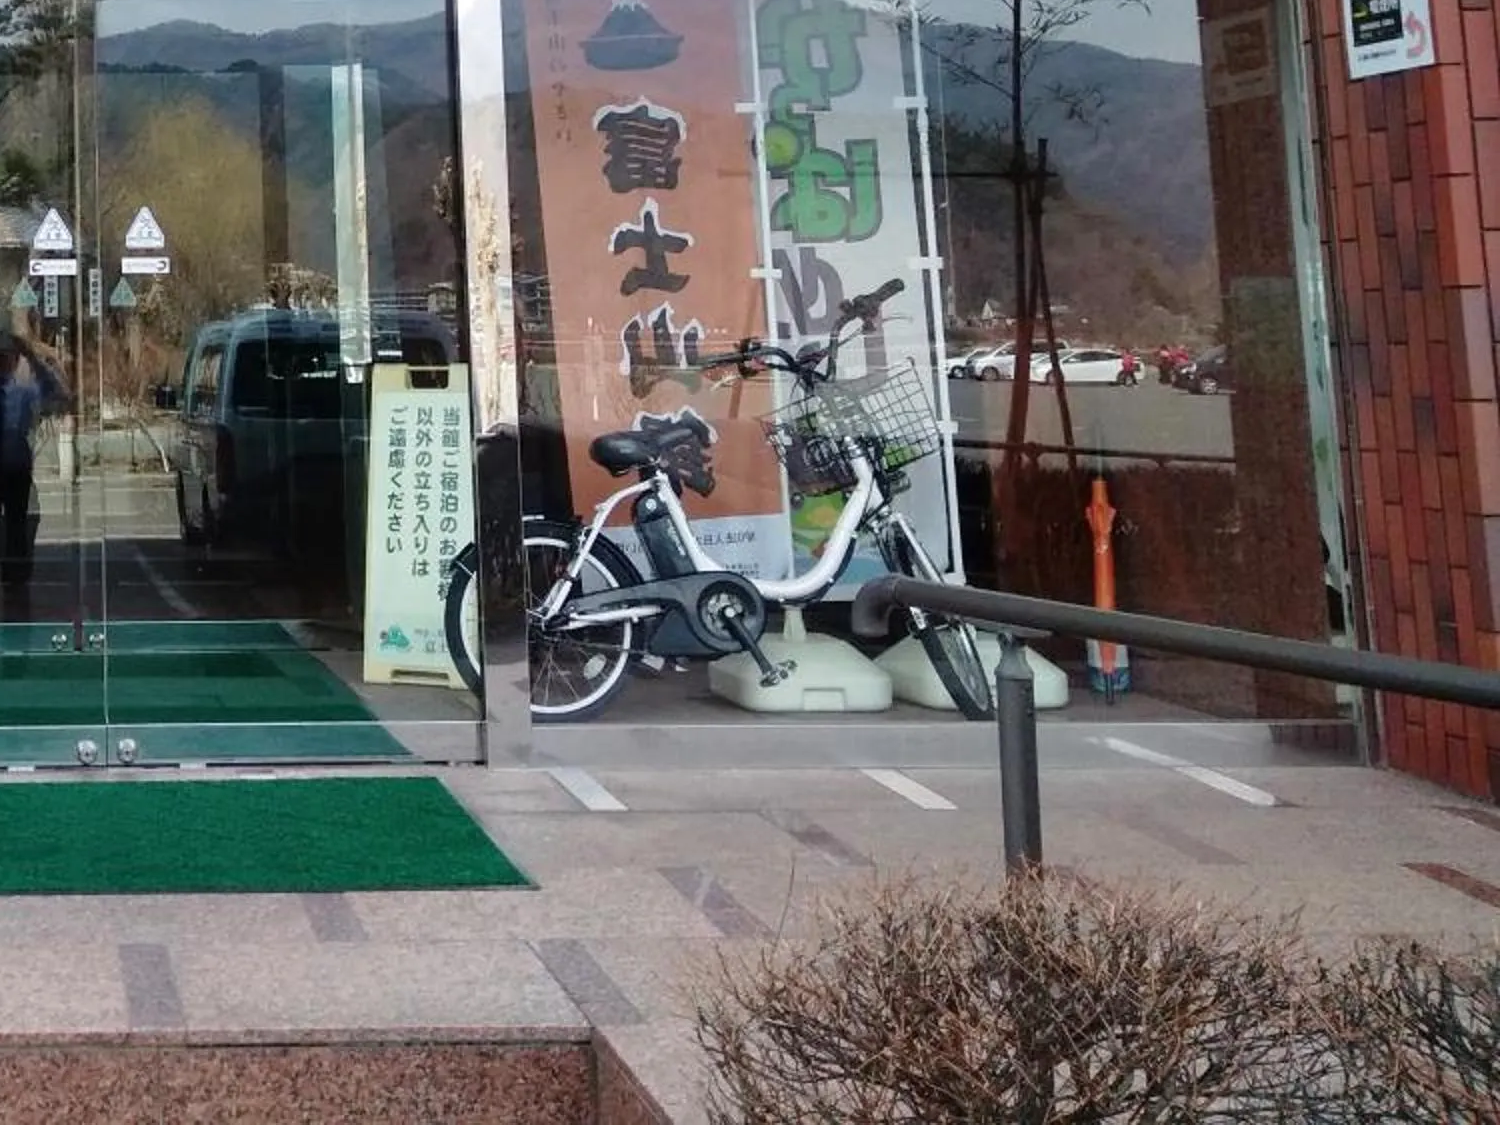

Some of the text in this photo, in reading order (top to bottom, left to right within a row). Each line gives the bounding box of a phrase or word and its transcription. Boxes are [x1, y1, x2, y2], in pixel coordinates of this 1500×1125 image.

[387, 407, 408, 554] ご遠慮ください
[411, 407, 435, 577] 以外の立ち入りは
